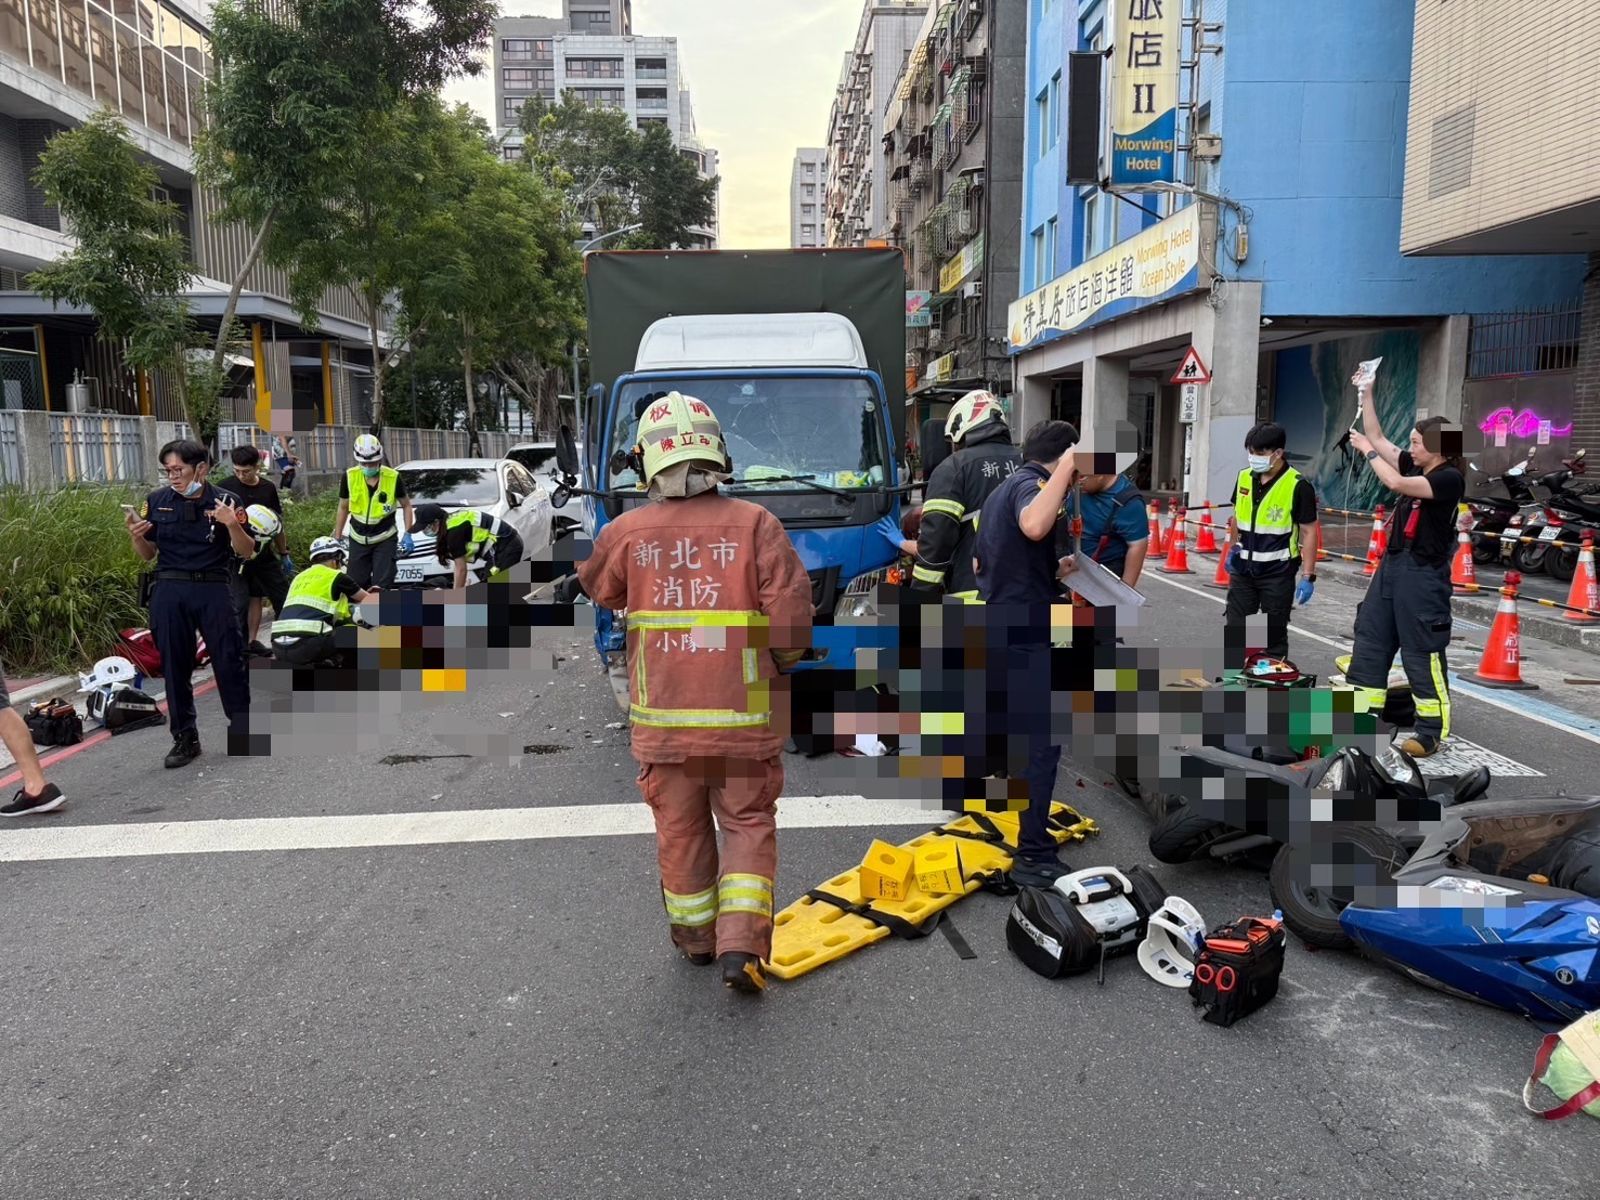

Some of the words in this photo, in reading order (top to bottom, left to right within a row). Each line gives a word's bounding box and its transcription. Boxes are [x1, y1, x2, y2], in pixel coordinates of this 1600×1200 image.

[1115, 137, 1173, 154] Morwing
[1125, 156, 1162, 171] Hotel
[1136, 238, 1168, 266] Morwing
[1170, 223, 1193, 250] Hotel
[1140, 267, 1165, 290] Ocean
[1165, 257, 1187, 285] Style
[633, 536, 740, 571] 新北市
[395, 568, 424, 580] -7055
[652, 575, 723, 609] 消防
[655, 631, 727, 654] 小隊
